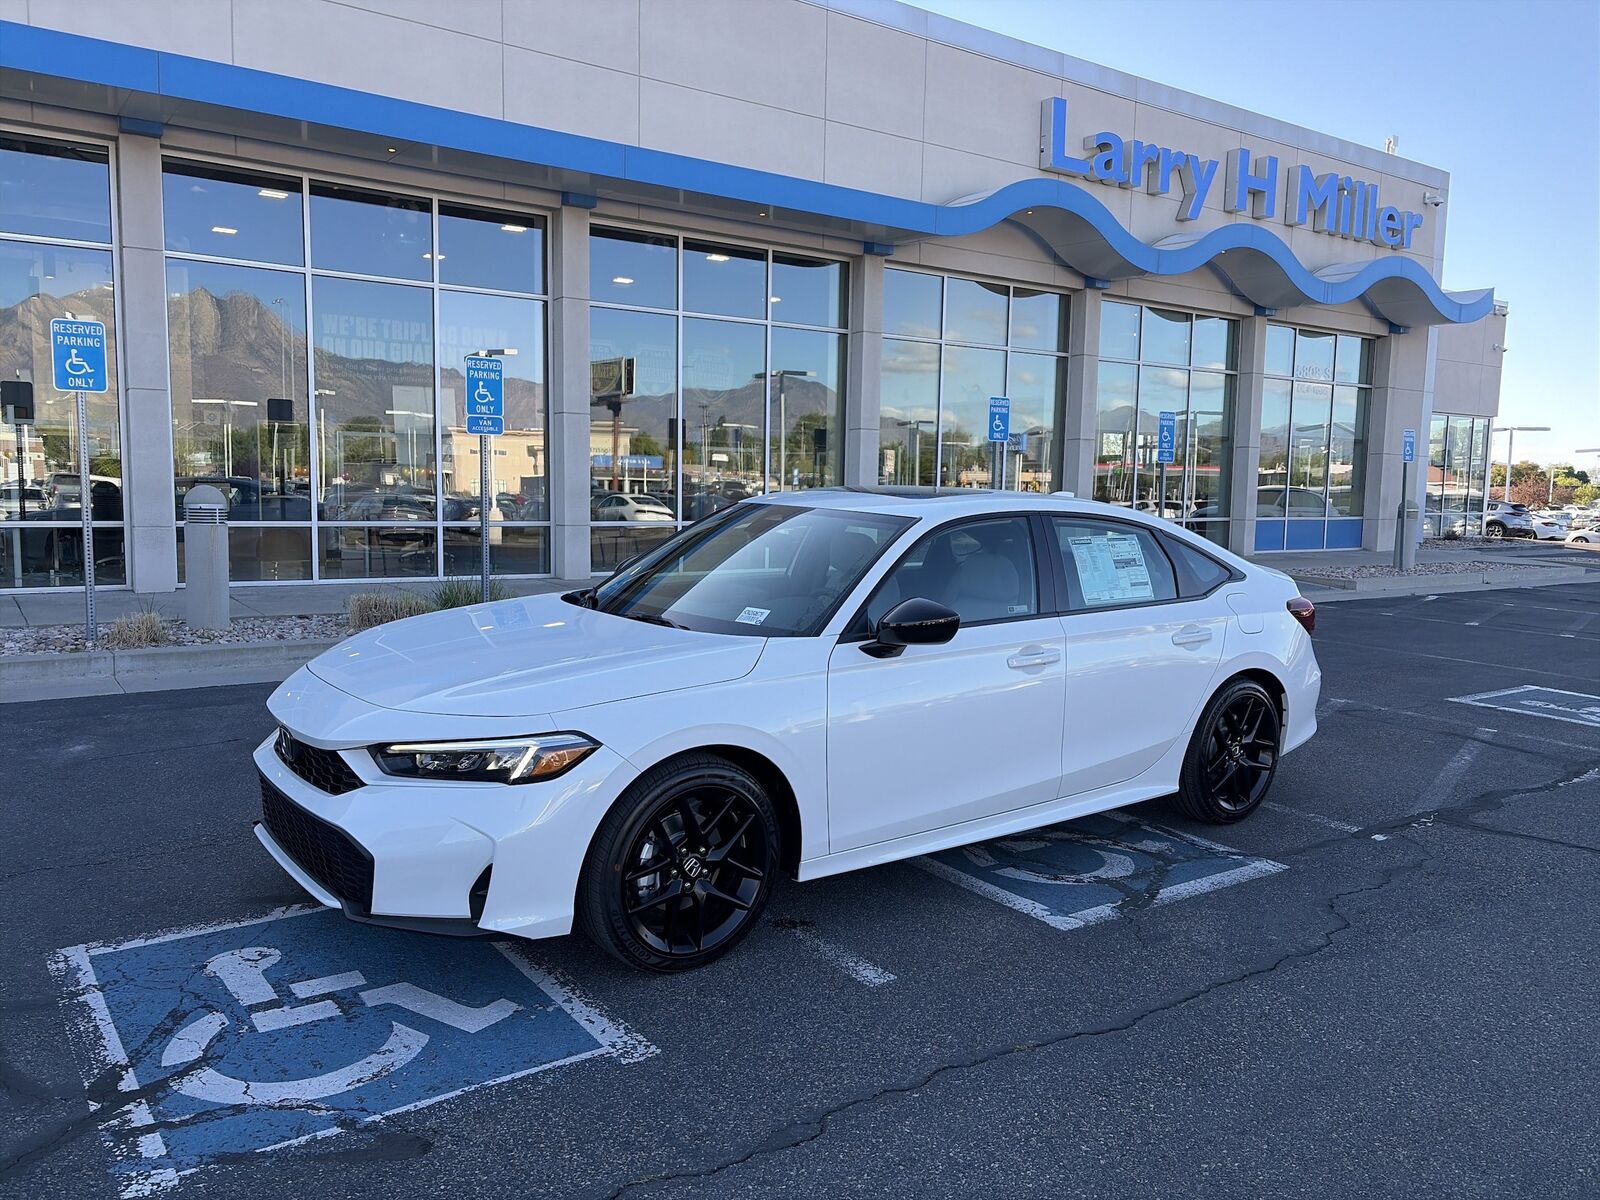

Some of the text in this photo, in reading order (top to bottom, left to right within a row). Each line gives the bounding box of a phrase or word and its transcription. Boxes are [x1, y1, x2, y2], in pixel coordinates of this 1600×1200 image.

[1040, 96, 1424, 250] Larry H Miller
[53, 323, 103, 335] RESERVED
[57, 335, 100, 347] PARKING
[467, 360, 502, 371] RESERVED
[469, 369, 500, 380] PARKING
[68, 377, 94, 387] ONLY
[476, 404, 495, 414] ONLY
